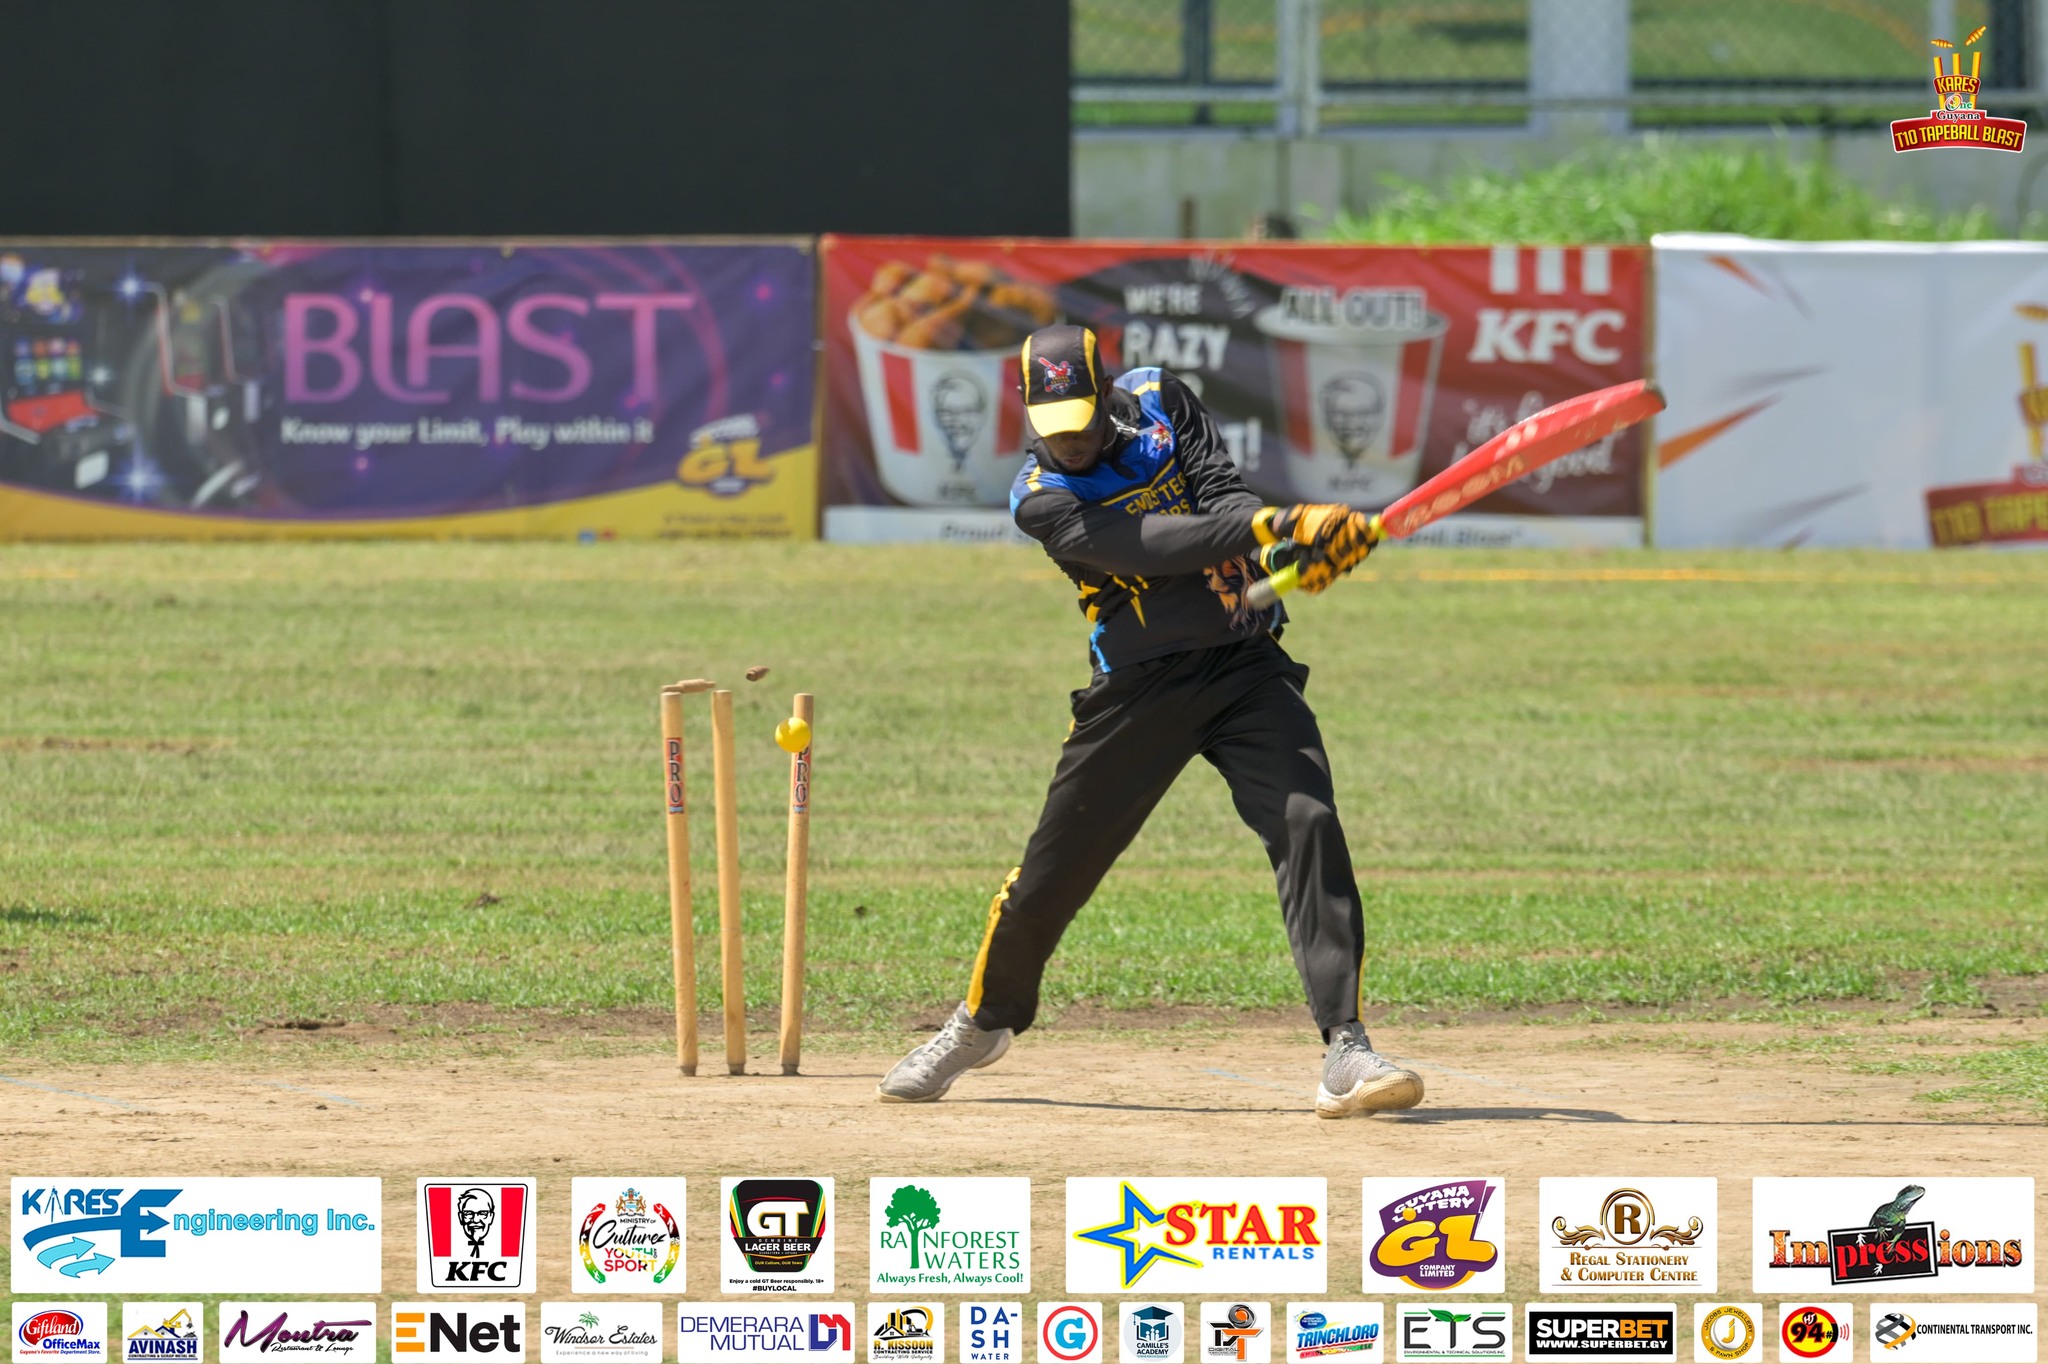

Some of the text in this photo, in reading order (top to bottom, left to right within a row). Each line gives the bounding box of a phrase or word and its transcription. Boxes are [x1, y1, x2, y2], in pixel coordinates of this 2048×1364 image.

[1123, 283, 1202, 316] WE'RE
[283, 291, 696, 404] BLAST
[1467, 307, 1625, 365] KFC
[281, 415, 350, 444] Know
[353, 420, 413, 450] your
[417, 415, 488, 448] Limit,
[494, 414, 550, 450] Play
[553, 415, 632, 444] within
[633, 415, 655, 444] it
[669, 740, 682, 803] PRO
